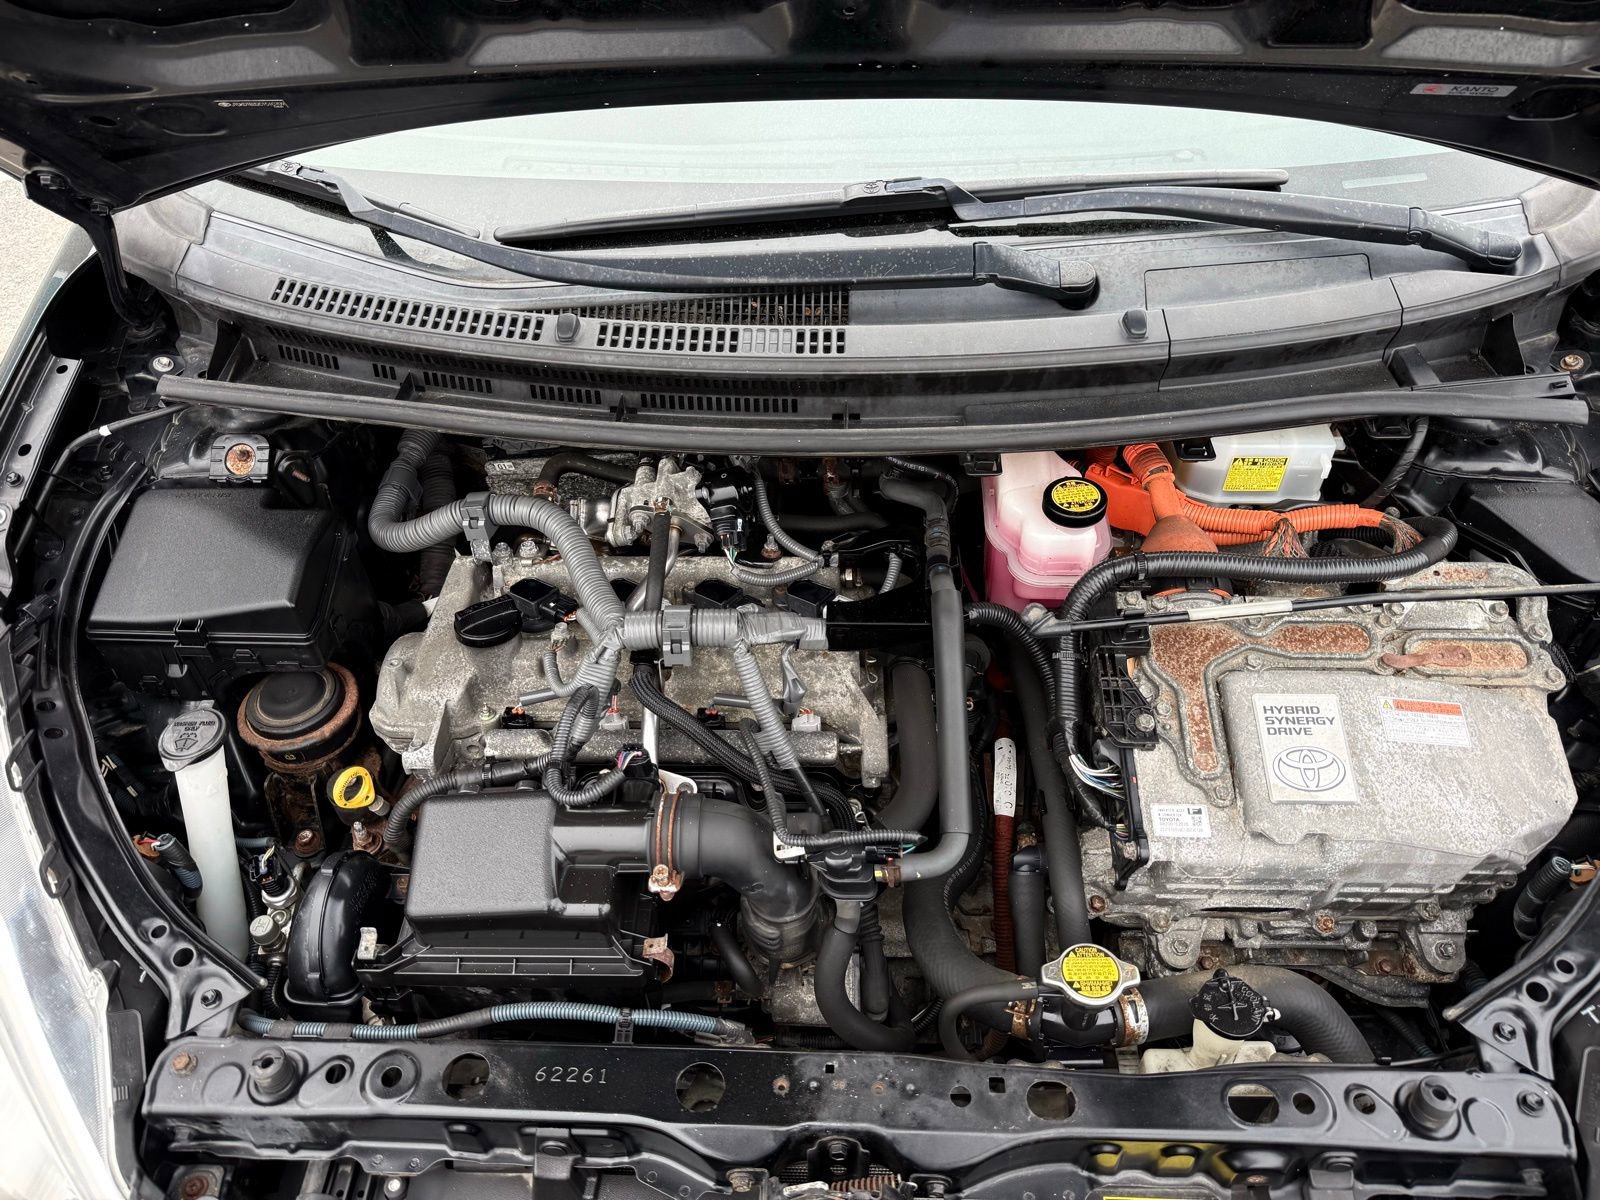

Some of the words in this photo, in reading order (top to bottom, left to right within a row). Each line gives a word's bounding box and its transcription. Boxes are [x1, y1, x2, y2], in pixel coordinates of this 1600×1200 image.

[1262, 705, 1321, 715] HYBRID
[1264, 716, 1336, 726] SYNERGY
[1266, 727, 1314, 736] DRIVE
[1241, 986, 1262, 1026] COOLANT
[535, 1066, 607, 1084] 62261
